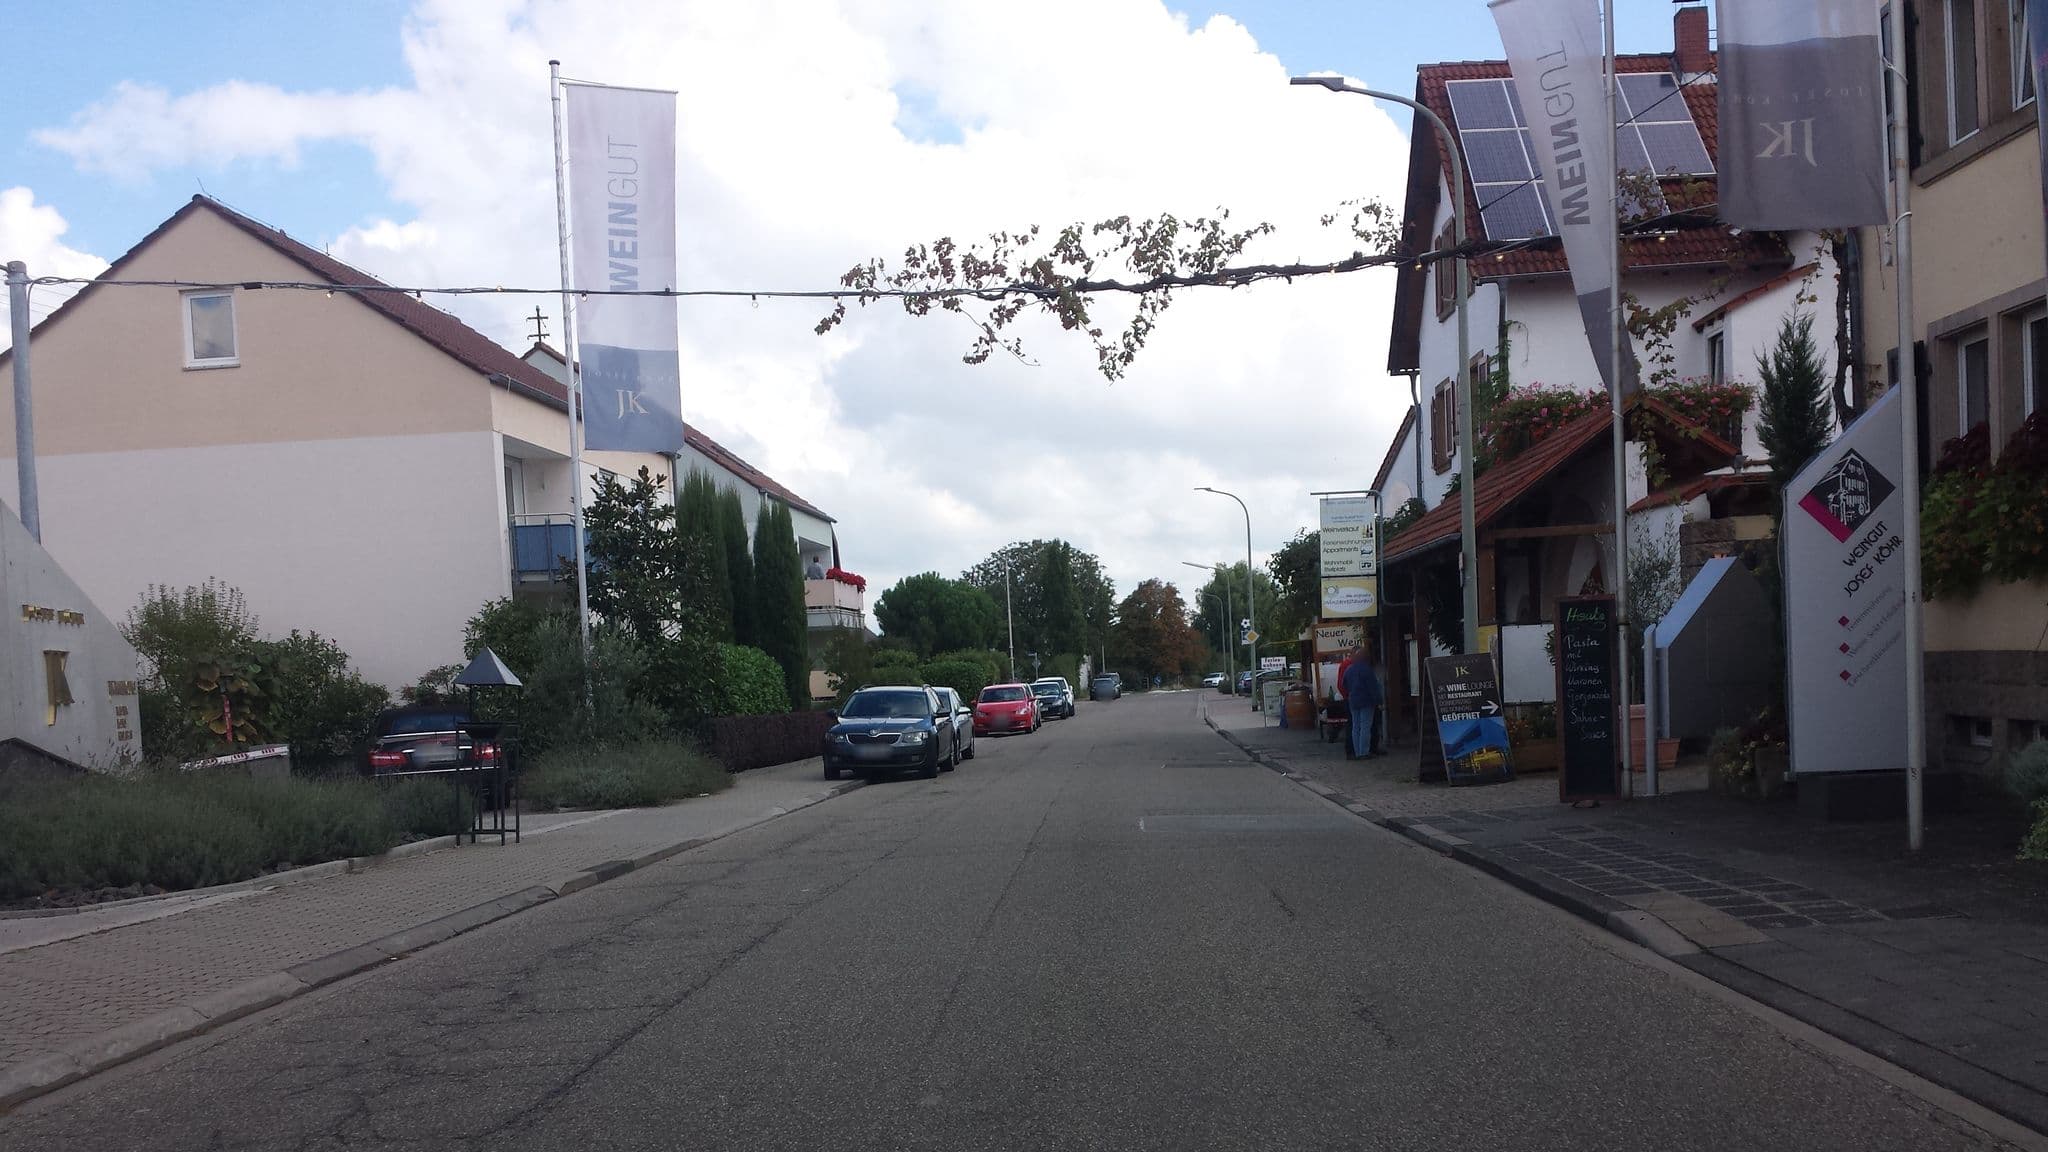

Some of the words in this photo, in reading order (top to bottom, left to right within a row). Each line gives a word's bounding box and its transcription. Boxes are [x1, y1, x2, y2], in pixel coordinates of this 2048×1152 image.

[607, 135, 639, 292] WEINGUT
[616, 389, 648, 420] JK
[1843, 520, 1888, 569] WEINGUT
[1843, 563, 1875, 599] JOSEF
[1875, 533, 1903, 568] KÖHR
[1315, 629, 1346, 639] Neuer
[1563, 633, 1601, 649] Pasta
[1337, 637, 1363, 649] Wein
[1455, 666, 1470, 679] JK
[1442, 711, 1481, 722] GEÖFFNET
